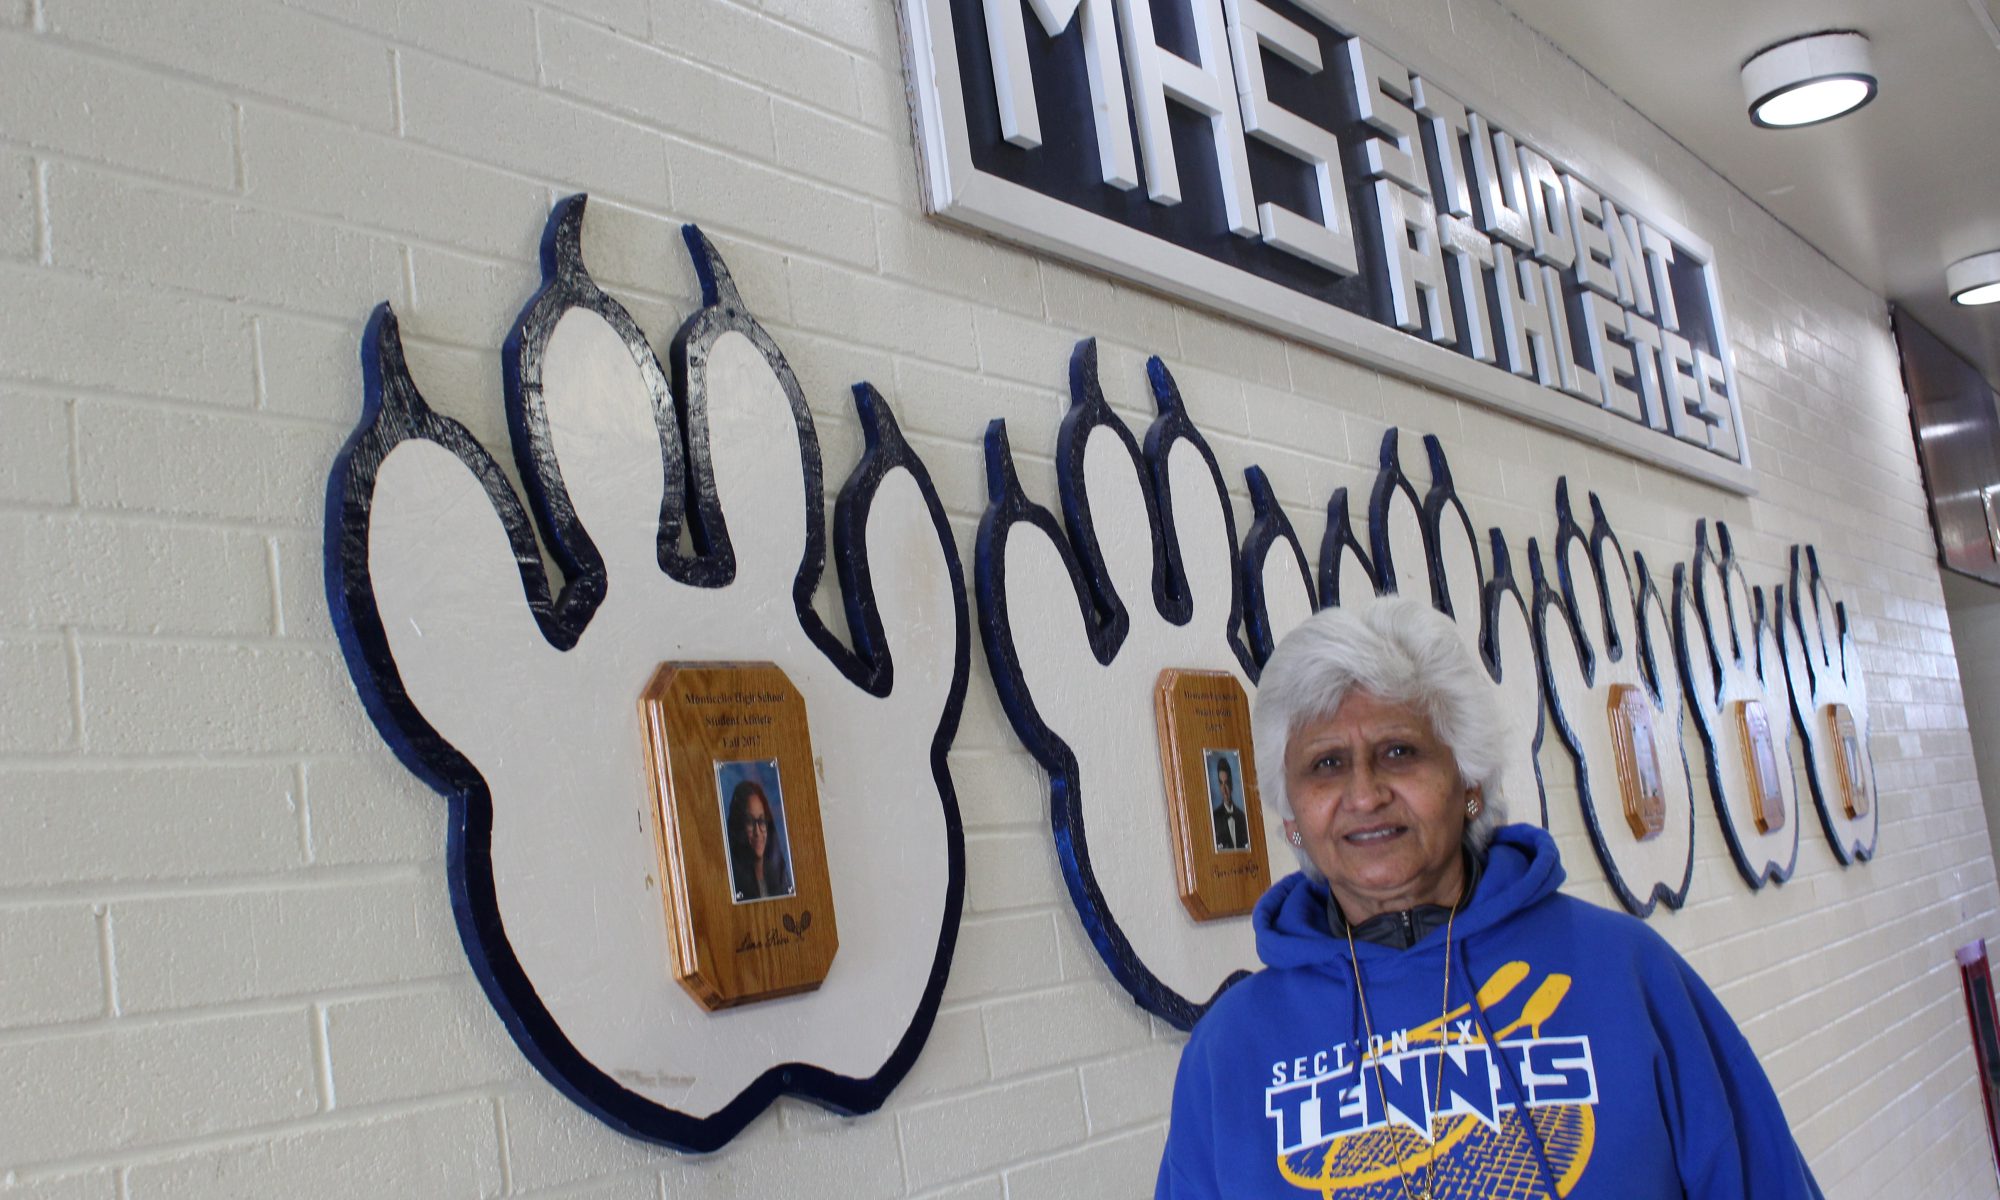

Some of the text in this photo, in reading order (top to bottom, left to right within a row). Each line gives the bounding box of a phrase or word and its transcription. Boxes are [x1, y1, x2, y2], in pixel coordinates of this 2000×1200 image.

[983, 0, 1360, 277] MHS
[1347, 36, 1680, 332] STUDENT
[1375, 178, 1741, 461] ATHLETES
[705, 713, 740, 727] Student
[758, 690, 785, 702] School
[1265, 1035, 1599, 1155] TENNIS
[1272, 1028, 1408, 1086] SECTON
